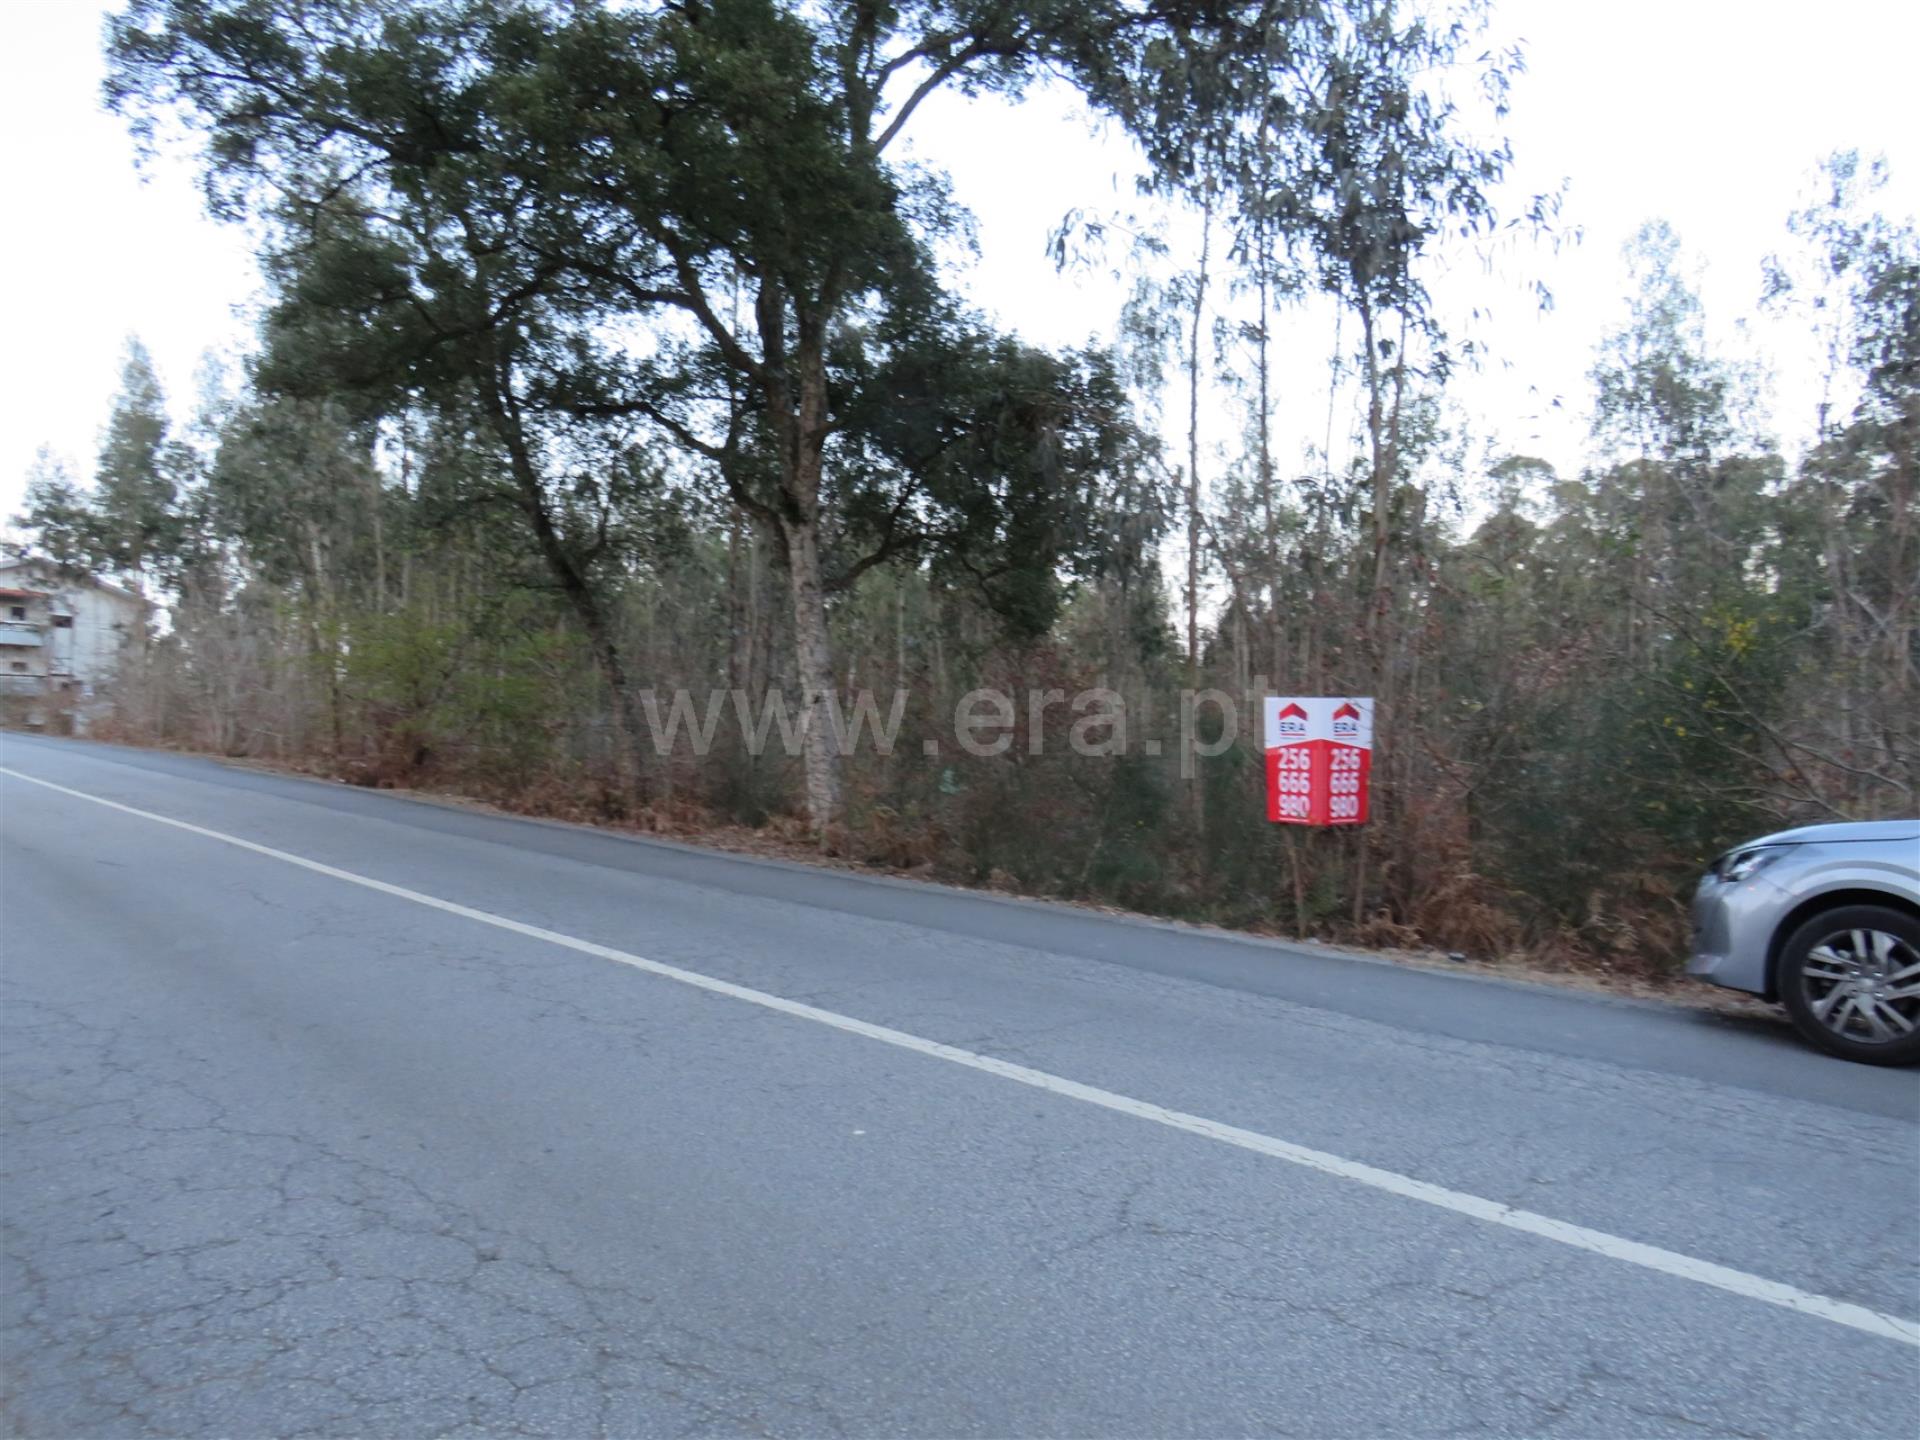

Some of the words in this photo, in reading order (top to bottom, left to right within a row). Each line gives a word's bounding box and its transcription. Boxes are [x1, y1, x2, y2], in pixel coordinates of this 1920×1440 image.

[1278, 748, 1310, 770] 256
[1330, 748, 1361, 770] 256
[1278, 771, 1310, 793] 666
